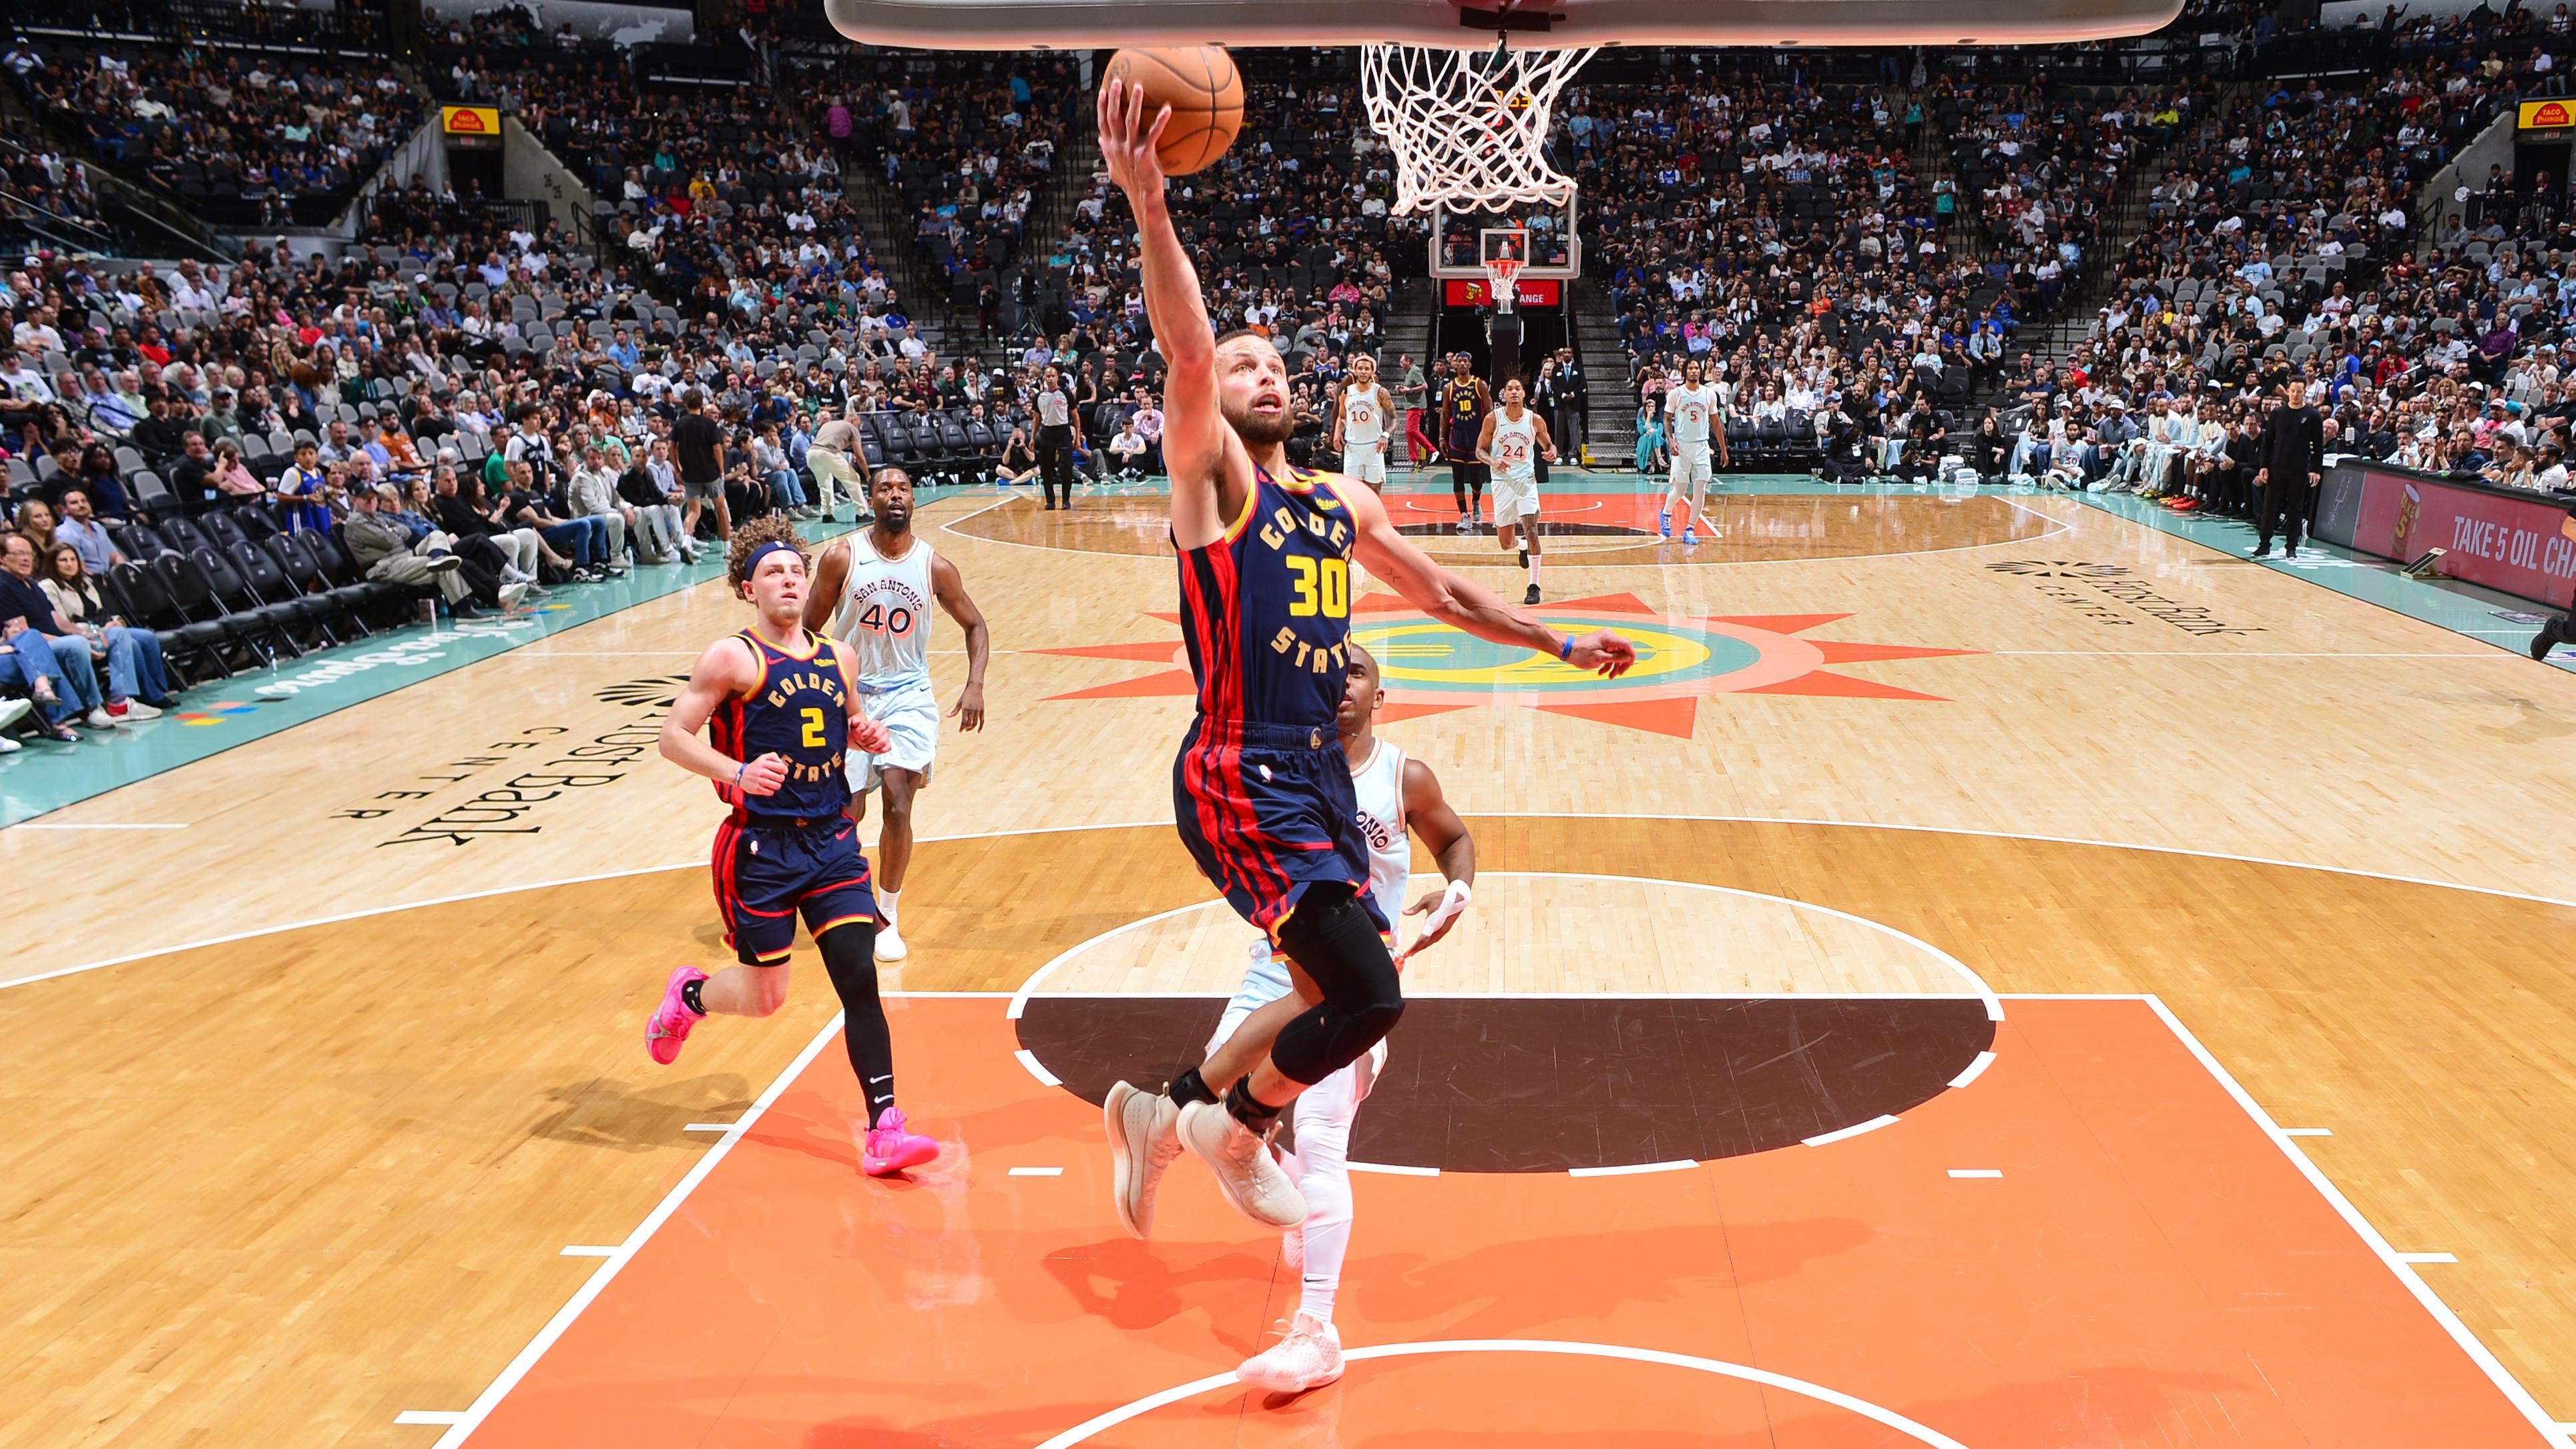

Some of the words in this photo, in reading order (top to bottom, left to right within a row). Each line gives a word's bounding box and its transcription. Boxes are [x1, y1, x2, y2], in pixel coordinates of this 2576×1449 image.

[1519, 294, 1543, 303] ANGE
[1351, 410, 1369, 422] 10
[1459, 400, 1472, 412] 10
[1690, 410, 1698, 422] 5
[1503, 445, 1525, 459] 24
[2396, 515, 2408, 539] 5
[2452, 516, 2496, 558] TAKE
[2495, 527, 2508, 561] 5
[2510, 529, 2538, 570] OIL
[854, 582, 878, 603] SAN
[880, 579, 923, 611] ANTONIO
[1286, 555, 1348, 618] 30
[860, 604, 913, 635] 40
[2034, 585, 2135, 625] CENTER
[768, 673, 845, 708] GOLDEN
[800, 707, 826, 748] 2
[329, 726, 569, 819] CENTER
[1356, 808, 1389, 850] ONIO
